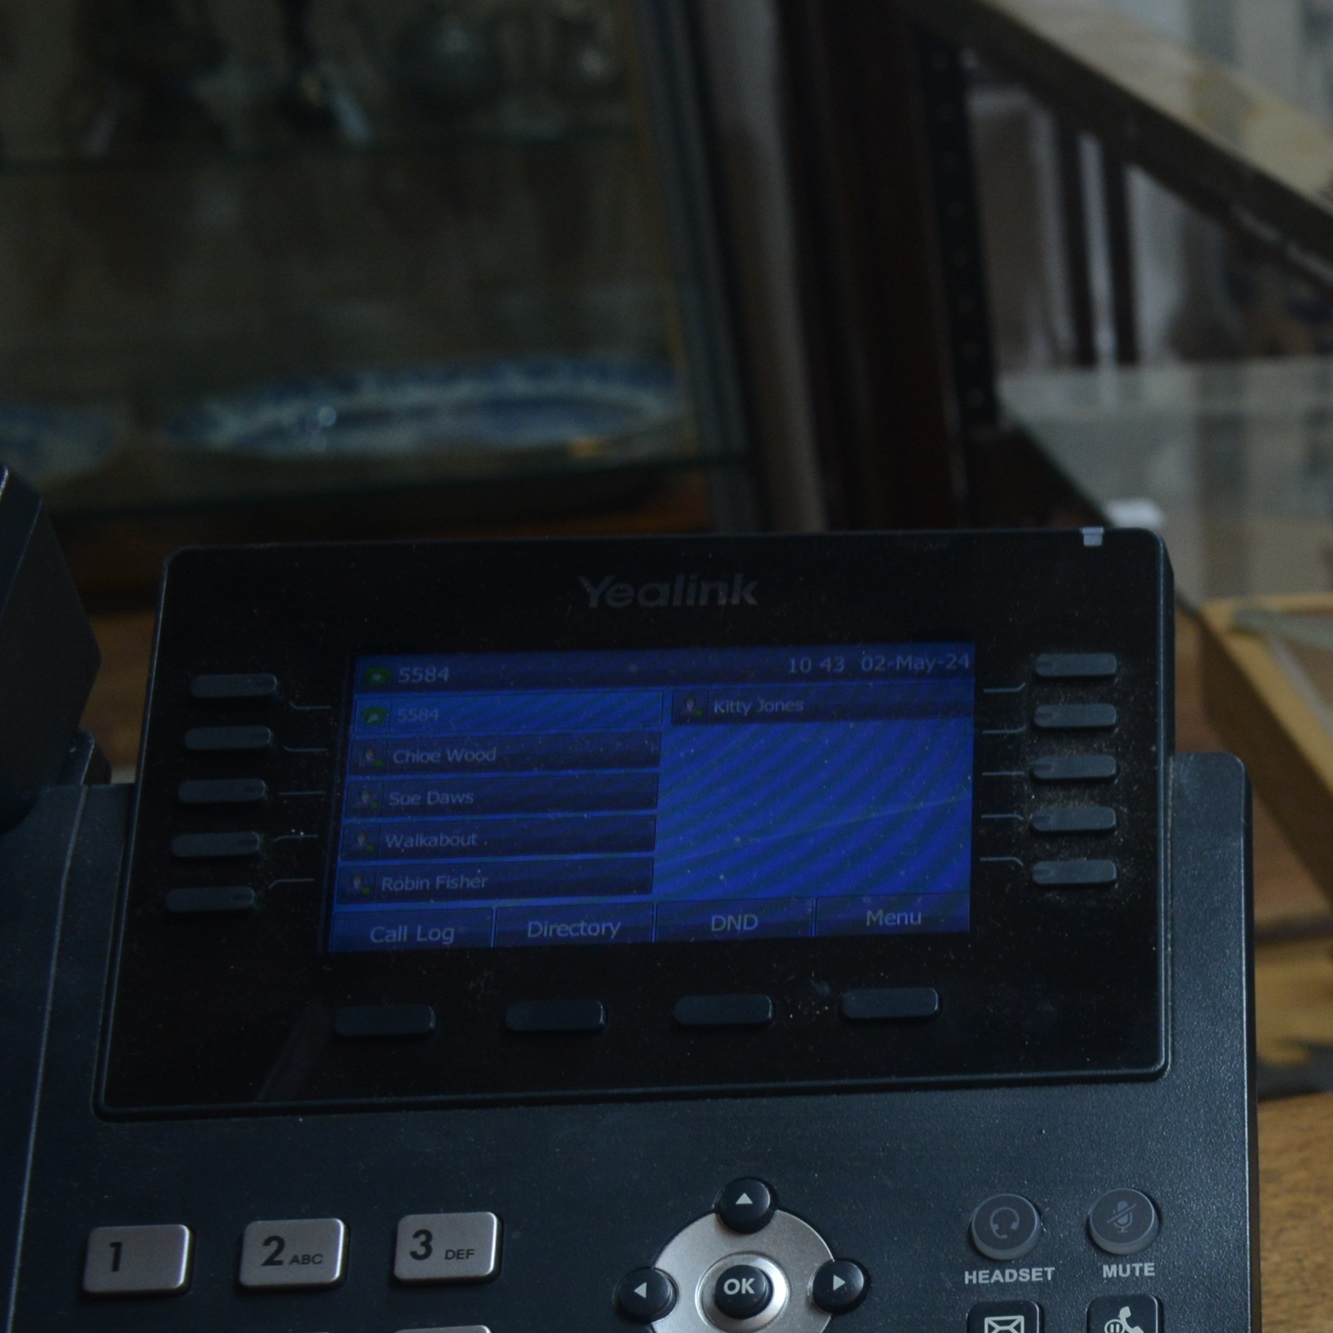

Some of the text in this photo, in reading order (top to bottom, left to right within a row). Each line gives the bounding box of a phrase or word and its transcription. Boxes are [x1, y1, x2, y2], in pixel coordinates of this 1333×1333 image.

[577, 572, 760, 609] Yealink
[860, 653, 971, 674] 02-May-24
[398, 666, 450, 683] 5584
[713, 696, 804, 717] Kitty Jones
[392, 746, 497, 764] Chloe Wood
[389, 789, 475, 806] Sue Daws
[385, 831, 478, 849] Walkabout
[382, 872, 488, 892] Robin Fisher
[711, 914, 758, 932] DND
[867, 908, 923, 927] Menu
[370, 922, 455, 945] Call Log
[527, 918, 621, 941] Directory
[261, 1235, 324, 1267] 2 ABC
[409, 1229, 476, 1261] 3 DEF
[109, 1242, 122, 1273] 1
[964, 1267, 1055, 1284] HEADSET
[1102, 1262, 1155, 1279] MUTE
[723, 1276, 755, 1295] OK
